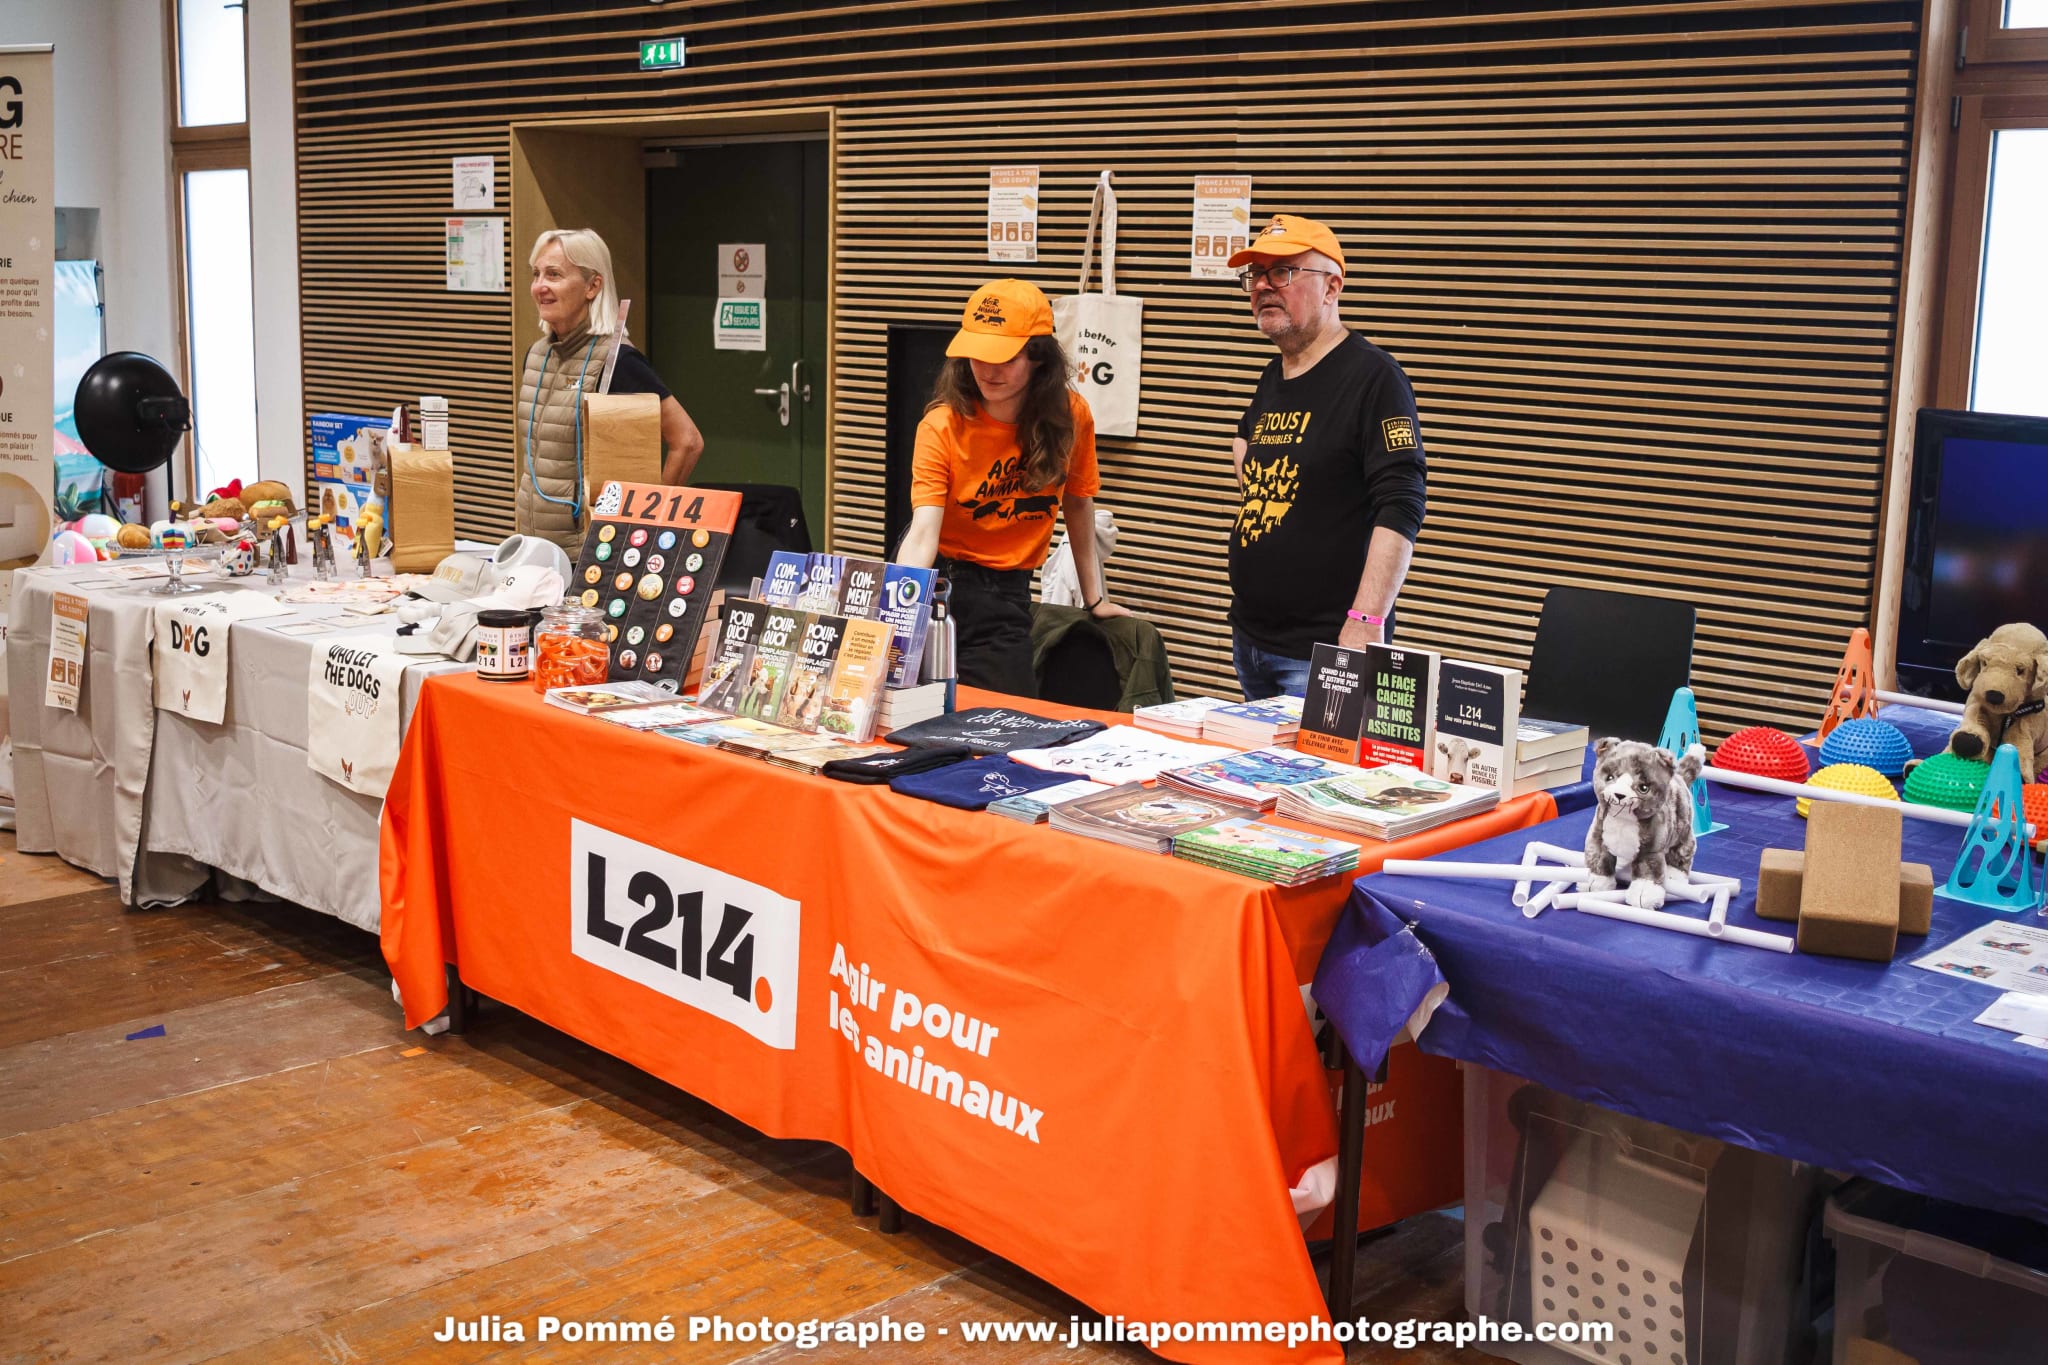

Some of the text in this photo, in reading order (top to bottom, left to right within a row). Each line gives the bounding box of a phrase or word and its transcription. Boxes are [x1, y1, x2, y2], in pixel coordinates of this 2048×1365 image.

[3, 189, 38, 204] chien
[733, 317, 760, 326] SECOURS
[1084, 328, 1117, 348] better
[1259, 433, 1294, 445] SENSIBLES
[775, 562, 800, 579] COM-
[810, 565, 835, 583] COM-
[769, 579, 796, 595] MENT
[850, 570, 876, 589] COM-
[806, 581, 833, 600] MENT
[846, 588, 874, 607] MENT
[729, 609, 755, 628] POUR
[767, 615, 797, 633] POUR-
[726, 624, 749, 641] QUOI
[763, 630, 788, 647] QUOI
[806, 623, 838, 641] POUR-
[802, 638, 829, 656] QUOI
[329, 644, 378, 668] WHO LET
[1391, 651, 1404, 661] L214
[324, 661, 381, 699] THE DOGS
[1321, 667, 1338, 676] QUAND
[1338, 669, 1345, 677] LA
[1322, 682, 1352, 694] LES MOYENS
[1346, 679, 1359, 688] PLUS
[1377, 671, 1416, 692] LA FACE
[348, 690, 374, 719] OUT
[1376, 688, 1415, 708] CACHÉE
[1377, 704, 1413, 724] DE NOS
[1444, 714, 1453, 722] Une
[1460, 704, 1482, 720] L214
[1367, 718, 1421, 742] ASSIETTES
[1317, 734, 1331, 742] FINIR
[1331, 737, 1344, 745] AVEC
[1327, 744, 1349, 754] INTENSIF
[1472, 762, 1498, 774] UN AUTRE
[1472, 769, 1488, 778] MONDE
[1472, 775, 1497, 787] POSSIBLE
[829, 942, 999, 1059] Agir pour
[829, 991, 1045, 1144] les animaux
